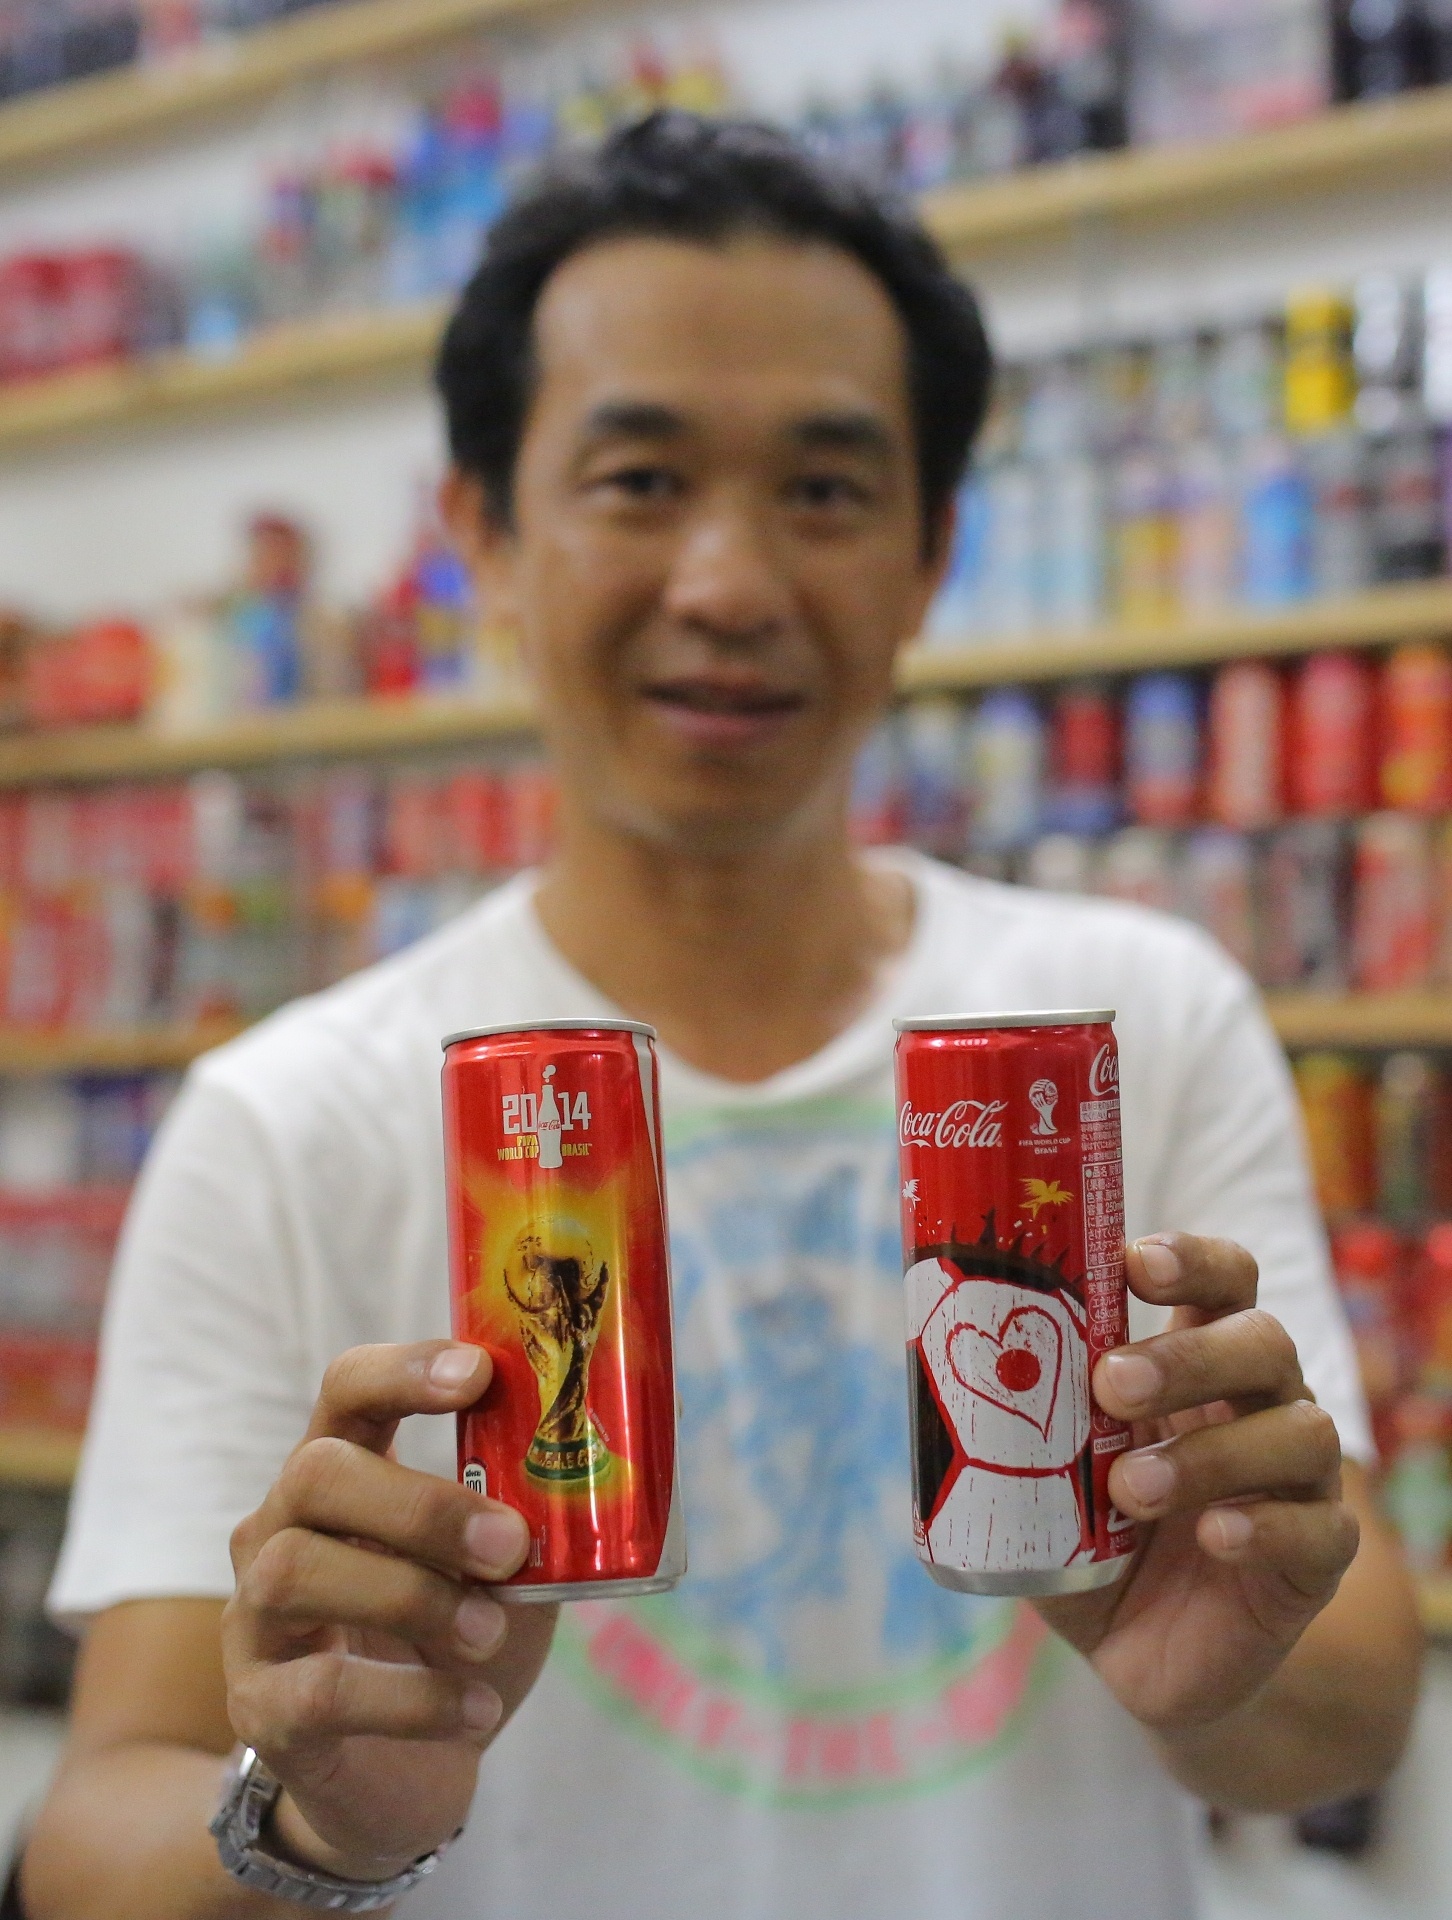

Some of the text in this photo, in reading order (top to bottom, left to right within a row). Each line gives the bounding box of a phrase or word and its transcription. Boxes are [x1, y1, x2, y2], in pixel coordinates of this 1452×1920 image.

[899, 1099, 1009, 1149] Coca-Cola
[1034, 1138, 1058, 1146] WORLD
[497, 1145, 540, 1161] WORLD CUP
